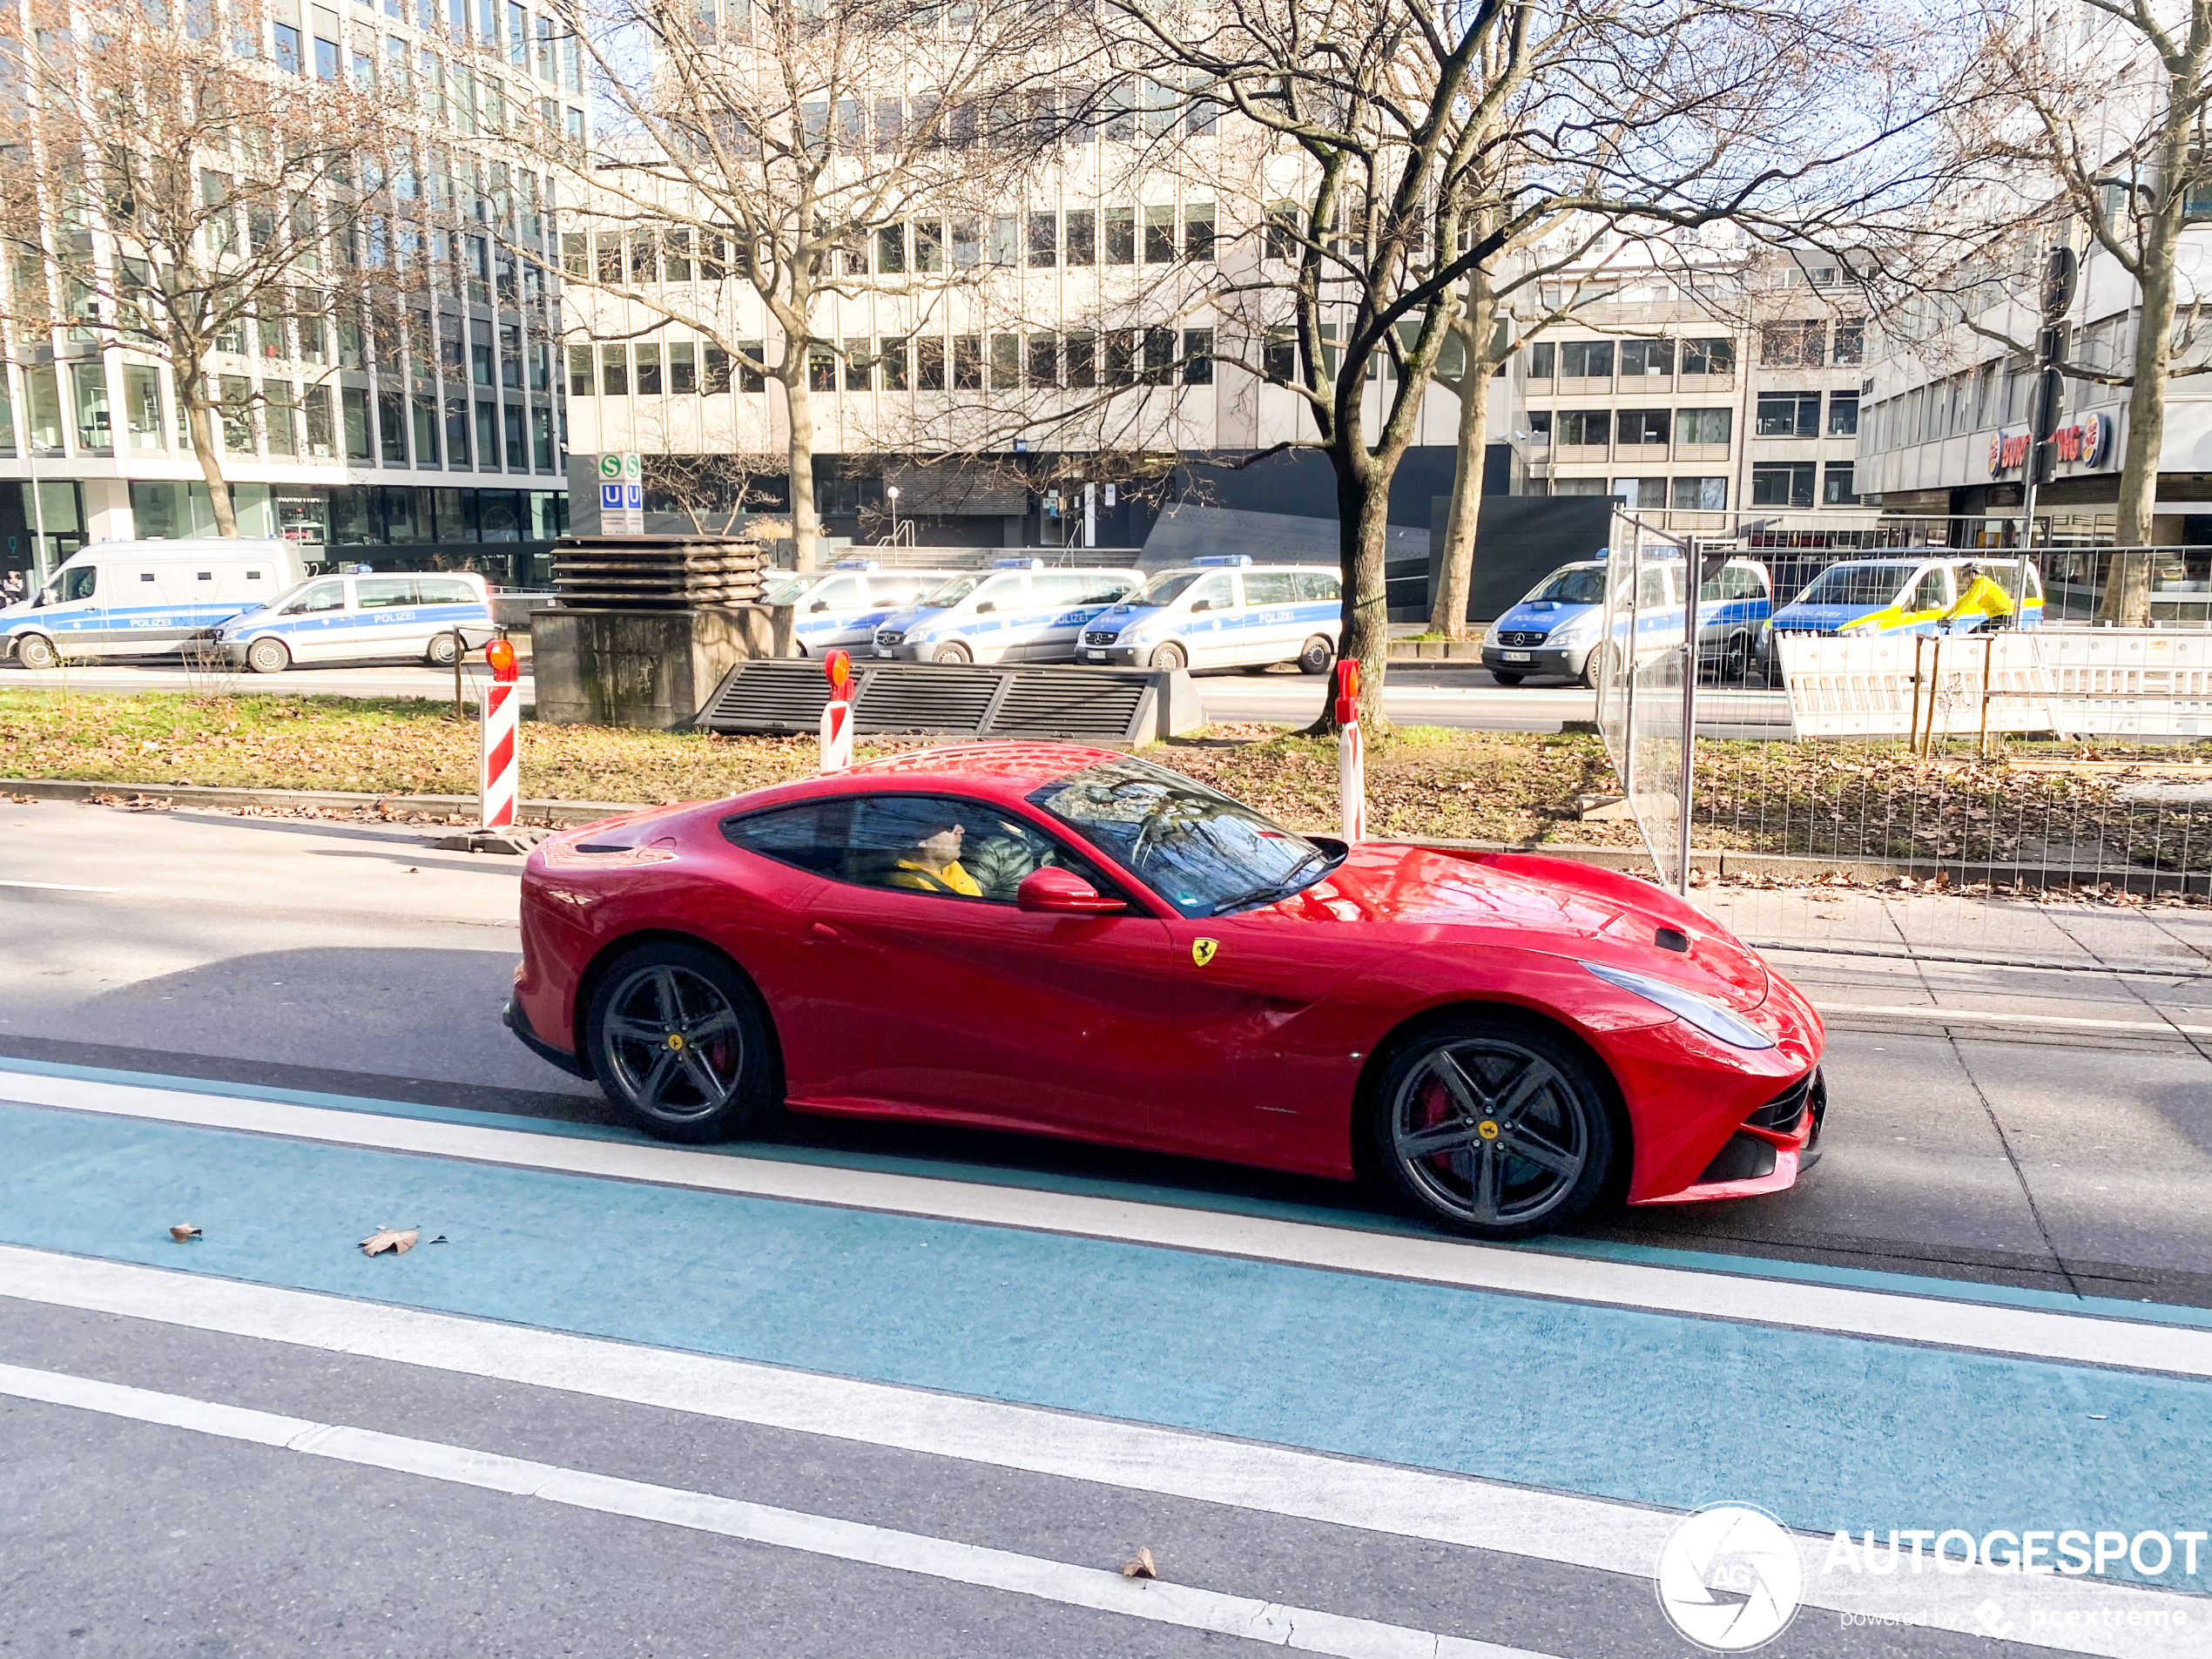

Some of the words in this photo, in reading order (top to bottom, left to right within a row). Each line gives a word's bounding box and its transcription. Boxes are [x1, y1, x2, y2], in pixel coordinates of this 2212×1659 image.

[604, 456, 619, 476] S
[628, 456, 638, 476] S
[604, 487, 619, 502] U
[629, 487, 639, 502] U
[130, 618, 172, 627] POLIZEI
[374, 611, 416, 624] POLIZEI
[1050, 613, 1089, 624] POLIZEI
[1258, 610, 1294, 624] POLIZEI
